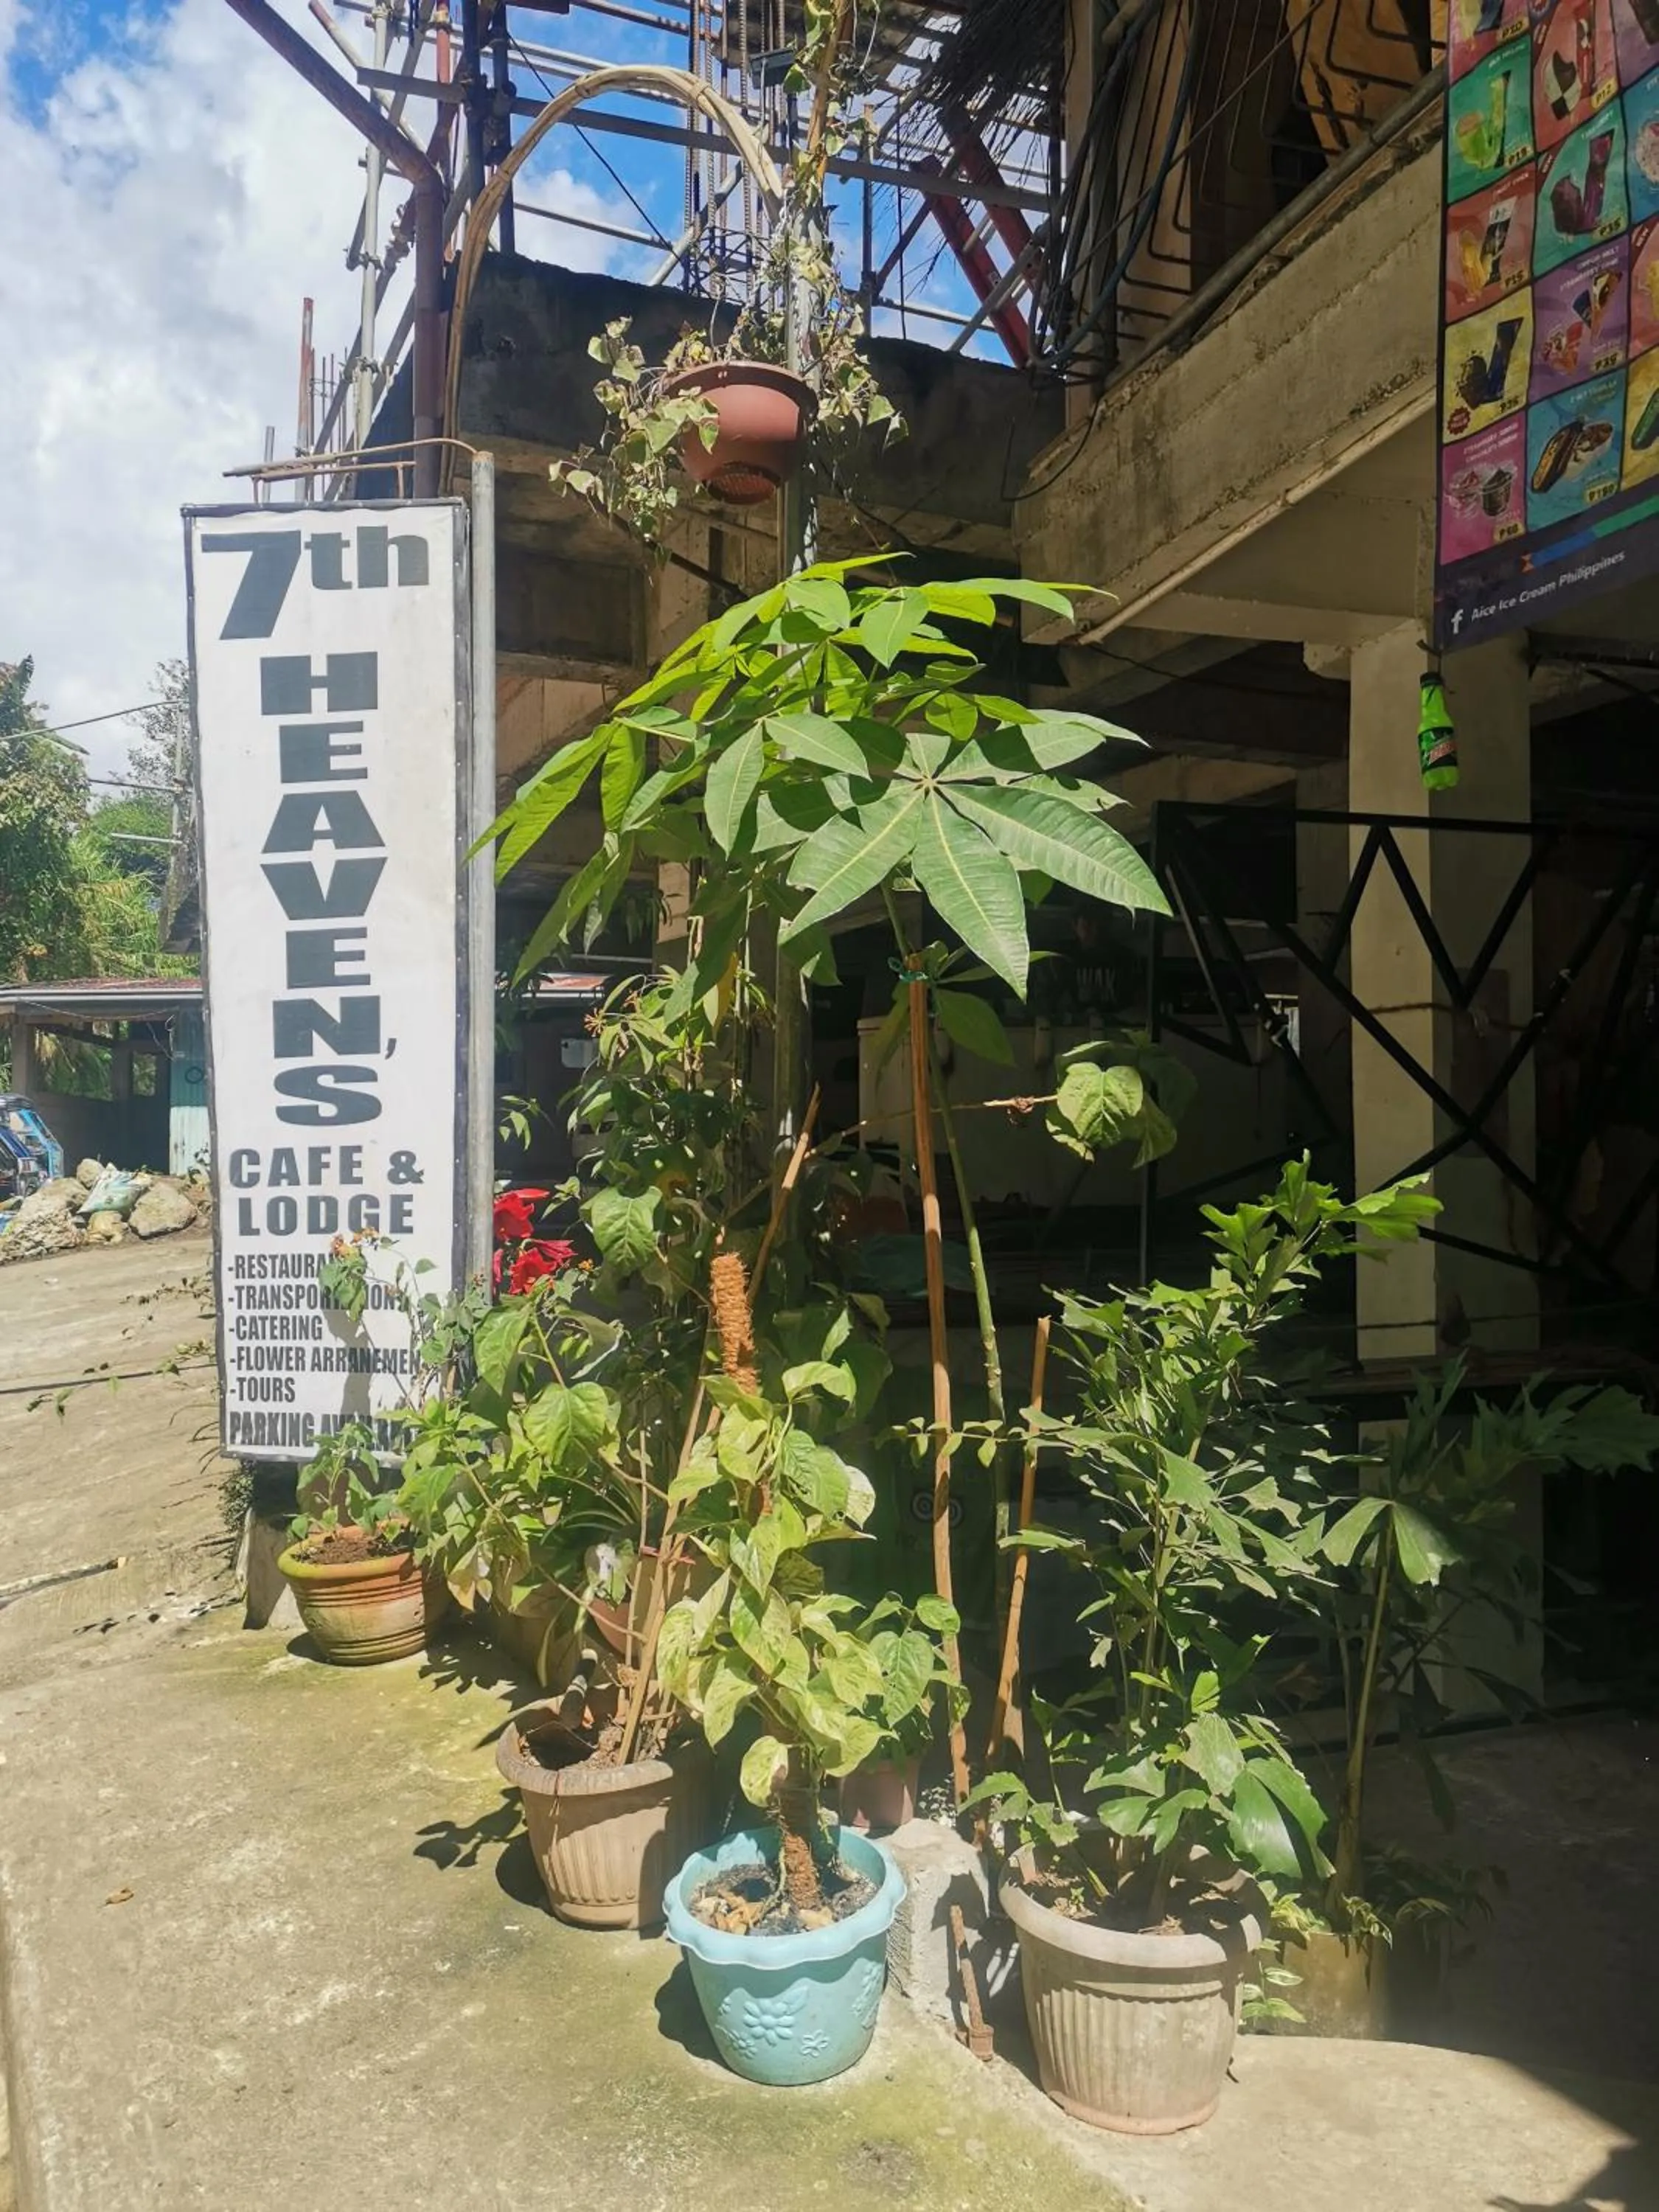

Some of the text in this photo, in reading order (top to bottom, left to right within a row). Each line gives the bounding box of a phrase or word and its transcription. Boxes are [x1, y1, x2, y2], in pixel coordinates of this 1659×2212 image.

[201, 526, 430, 641] 7th
[1470, 604, 1497, 624] Aice
[1499, 596, 1517, 611] Ice
[1519, 580, 1557, 603] Cream
[1558, 550, 1626, 588] Philippines
[228, 1144, 425, 1189] CAFE &
[237, 1194, 414, 1237] LODGE
[310, 1347, 422, 1375] ARRANEMEN
[229, 1411, 316, 1447] PARKING
